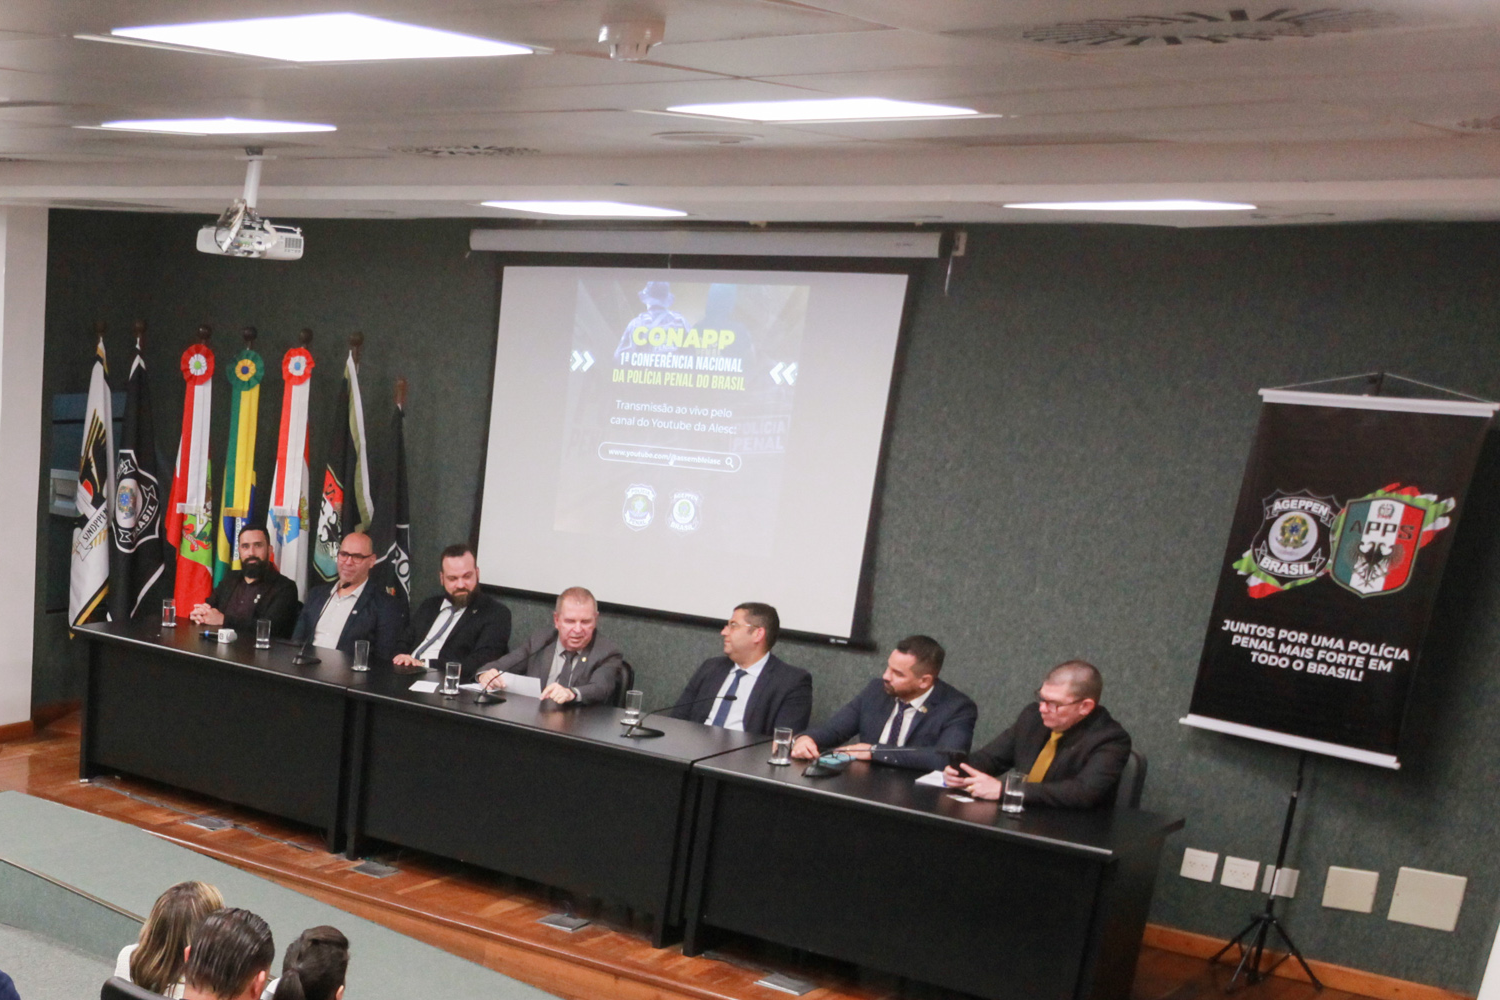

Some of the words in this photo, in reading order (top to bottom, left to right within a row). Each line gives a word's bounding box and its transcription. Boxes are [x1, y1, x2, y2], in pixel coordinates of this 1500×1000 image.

[632, 326, 736, 350] CONAPP
[631, 352, 693, 370] CONFERÊNCIA
[695, 355, 743, 373] NACIONAL
[612, 369, 625, 383] DA
[627, 369, 662, 386] POLÍCIA
[664, 372, 694, 388] PENAL
[696, 374, 709, 389] DO
[711, 375, 746, 391] BRASIL
[616, 400, 673, 414] Transmissão
[675, 405, 688, 415] ao
[689, 406, 708, 417] vivo
[710, 407, 732, 419] pelo
[610, 416, 635, 427] canal
[637, 417, 650, 427] do
[651, 418, 691, 431] Youtube
[694, 421, 706, 432] da
[708, 422, 737, 435] Alesc:
[1273, 498, 1329, 516] AGEPPEN
[1350, 520, 1415, 540] APPS
[1259, 555, 1314, 575] BRASIL
[1221, 619, 1276, 639] JUNTOS
[1277, 629, 1309, 645] POR
[1311, 634, 1344, 650] UMA
[1348, 640, 1410, 661] POLÍCIA
[1231, 634, 1276, 653] PENAL
[1278, 642, 1314, 659] MAIS
[1317, 650, 1365, 668] FORTE
[1368, 658, 1393, 673] EM
[1250, 651, 1290, 669] TODO
[1292, 660, 1304, 671] O
[1306, 661, 1364, 682] BRASIL!
